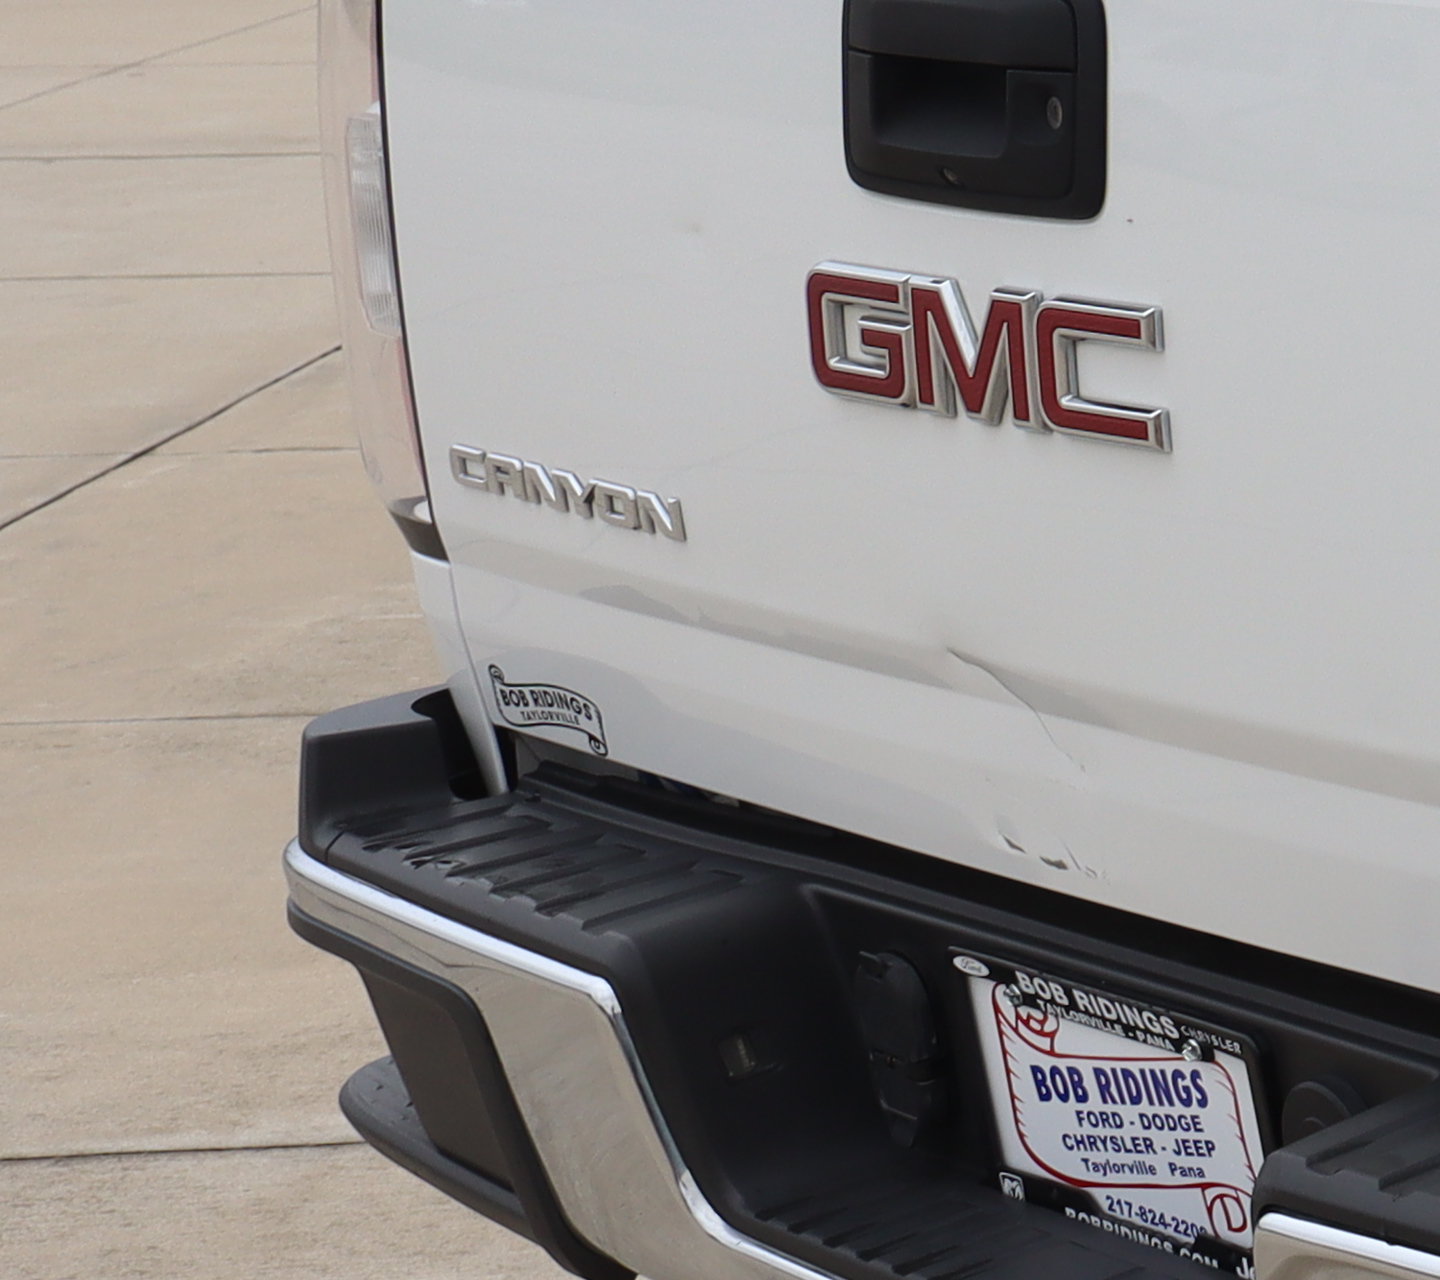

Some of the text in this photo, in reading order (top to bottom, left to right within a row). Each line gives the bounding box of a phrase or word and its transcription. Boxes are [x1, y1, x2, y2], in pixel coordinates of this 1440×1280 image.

[807, 260, 1173, 453] GMC
[450, 443, 687, 542] CANYON
[500, 688, 592, 721] BOB RIDINGS
[520, 710, 580, 725] TAYLORVILLE
[1016, 971, 1180, 1039] BOB RIDINGS
[1036, 999, 1126, 1038] TAYLORVILLE
[1137, 1029, 1176, 1052] PANA
[1030, 1064, 1209, 1108] BOB RIDINGS
[1075, 1110, 1125, 1129] FORD
[1139, 1113, 1205, 1133] DODGE
[1062, 1133, 1157, 1155] CHRYSLER
[1172, 1138, 1216, 1158] JEEP
[1081, 1158, 1206, 1179] Taylorville Pana
